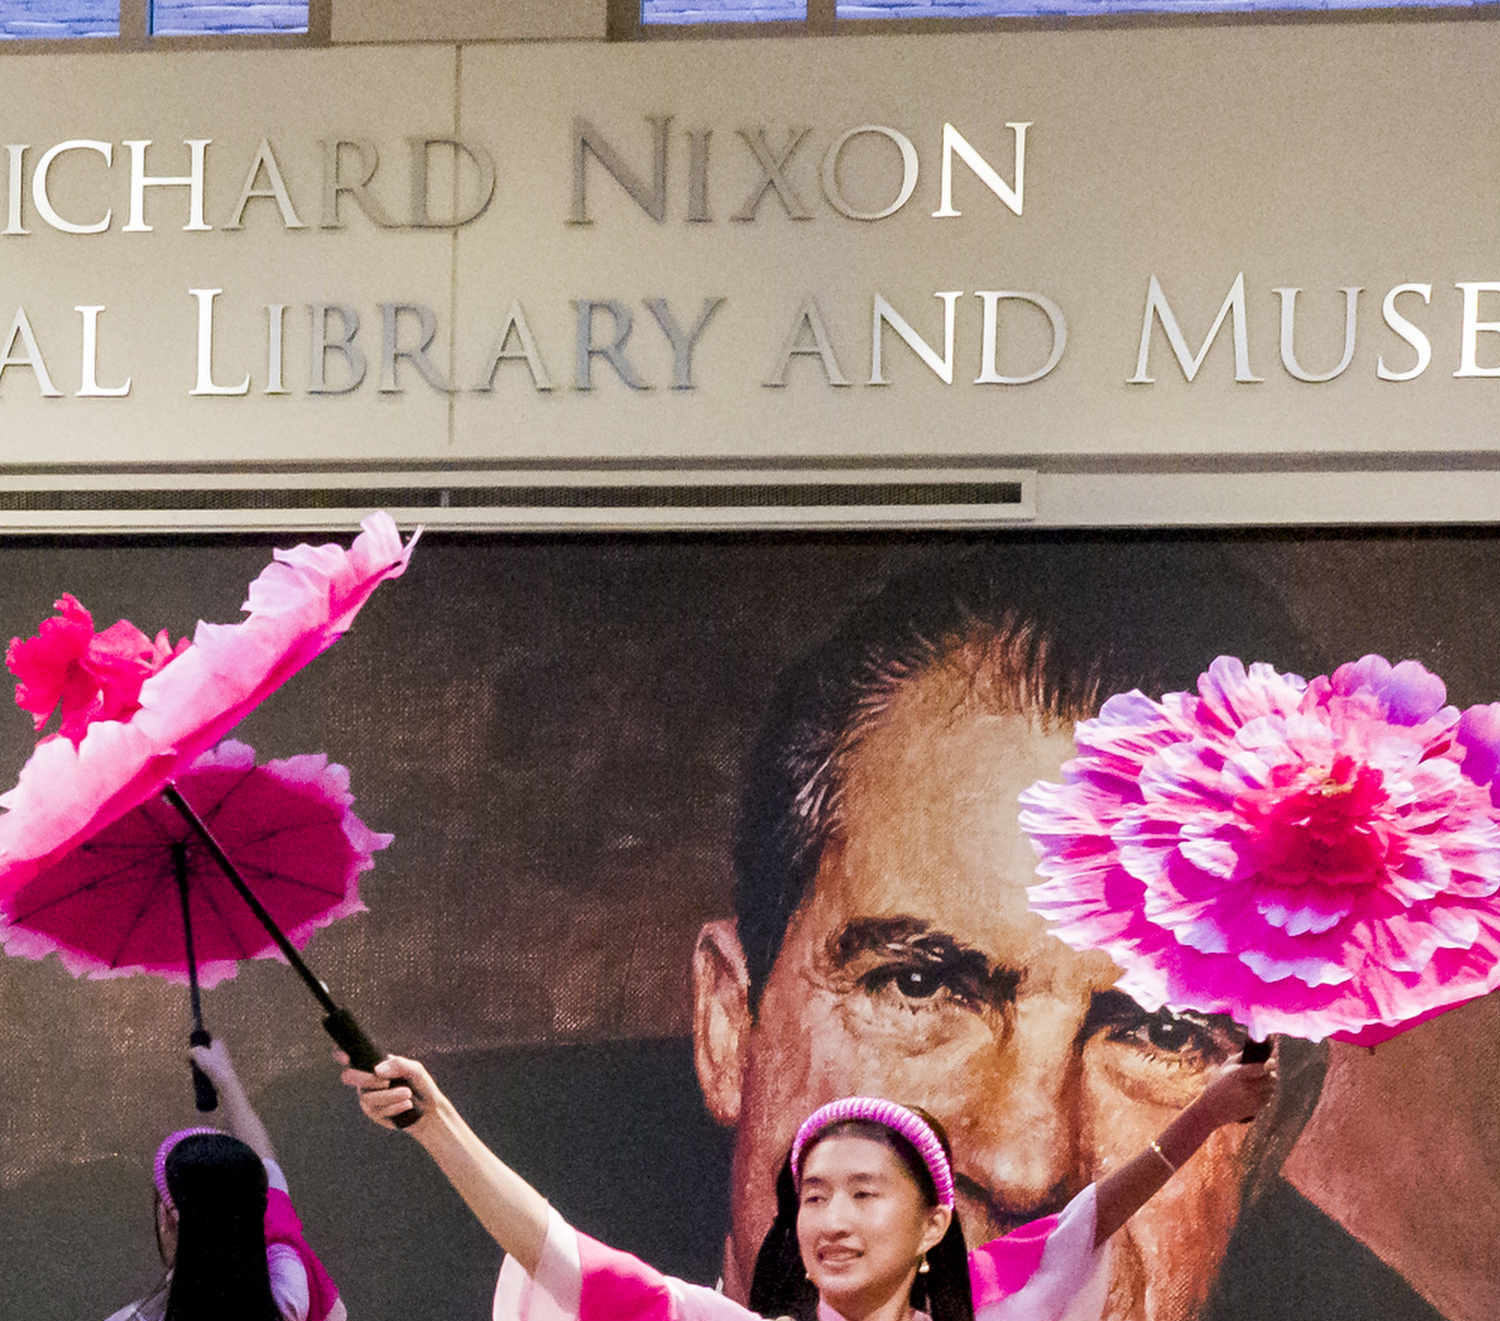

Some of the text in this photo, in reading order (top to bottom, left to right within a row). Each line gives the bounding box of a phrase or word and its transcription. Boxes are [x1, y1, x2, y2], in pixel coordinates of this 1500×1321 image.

[564, 114, 1034, 226] NIXON
[188, 288, 727, 397] LIBRARY
[766, 289, 1068, 389] AND
